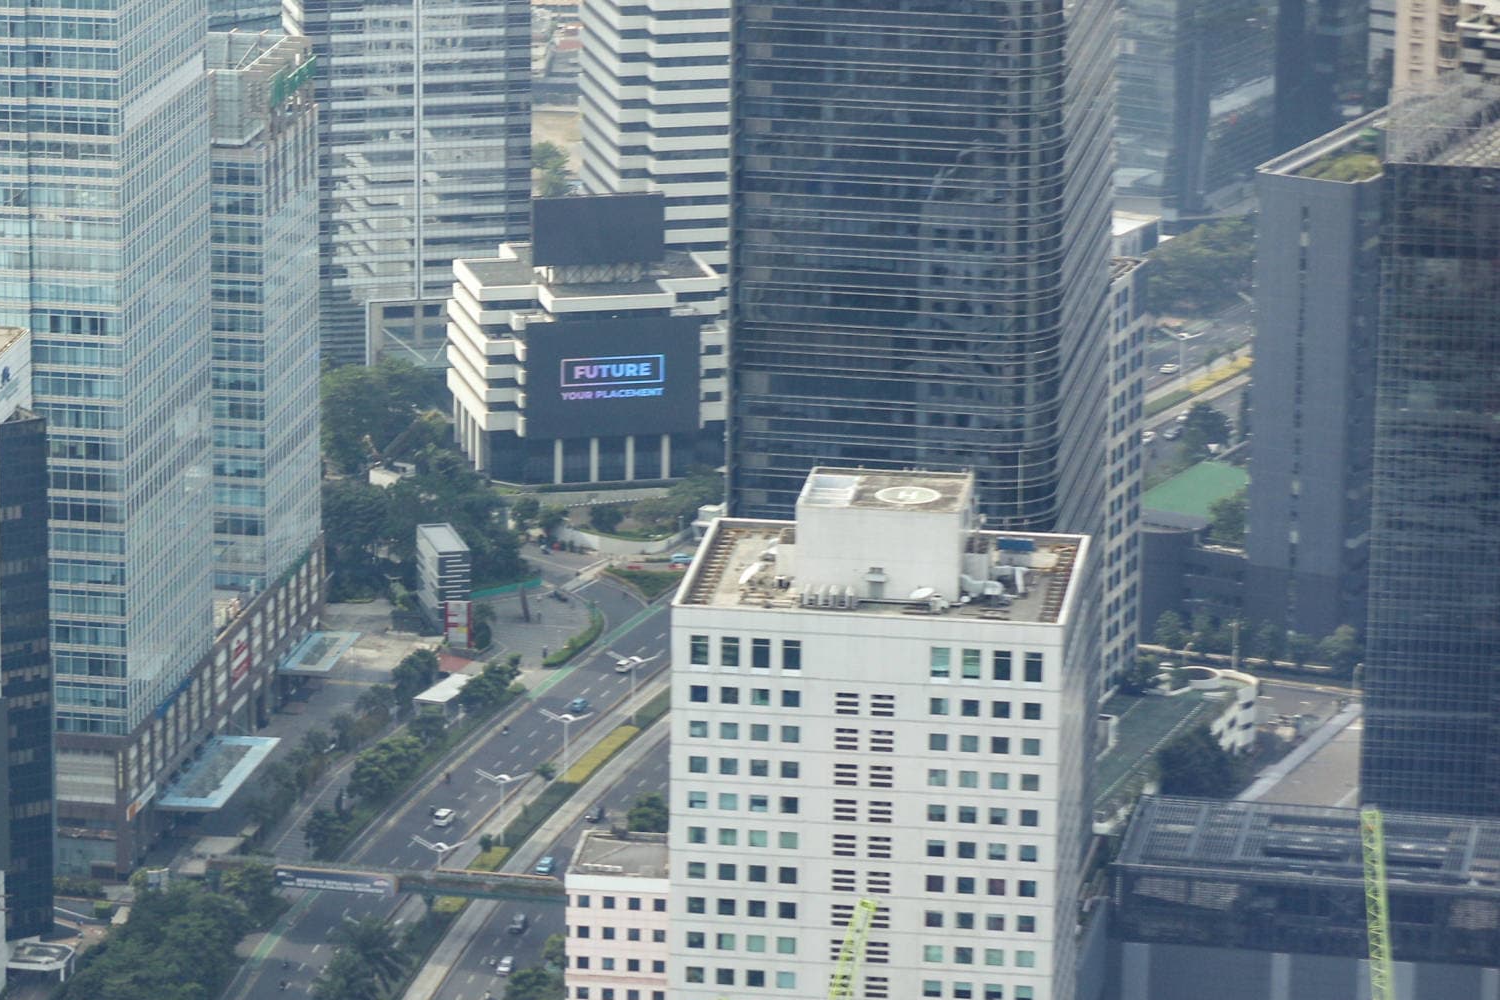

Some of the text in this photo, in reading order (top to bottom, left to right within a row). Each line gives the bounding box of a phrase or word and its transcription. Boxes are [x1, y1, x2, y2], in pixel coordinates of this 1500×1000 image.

[573, 362, 652, 379] FUTURE
[561, 387, 664, 400] YOUR PLACEMENT
